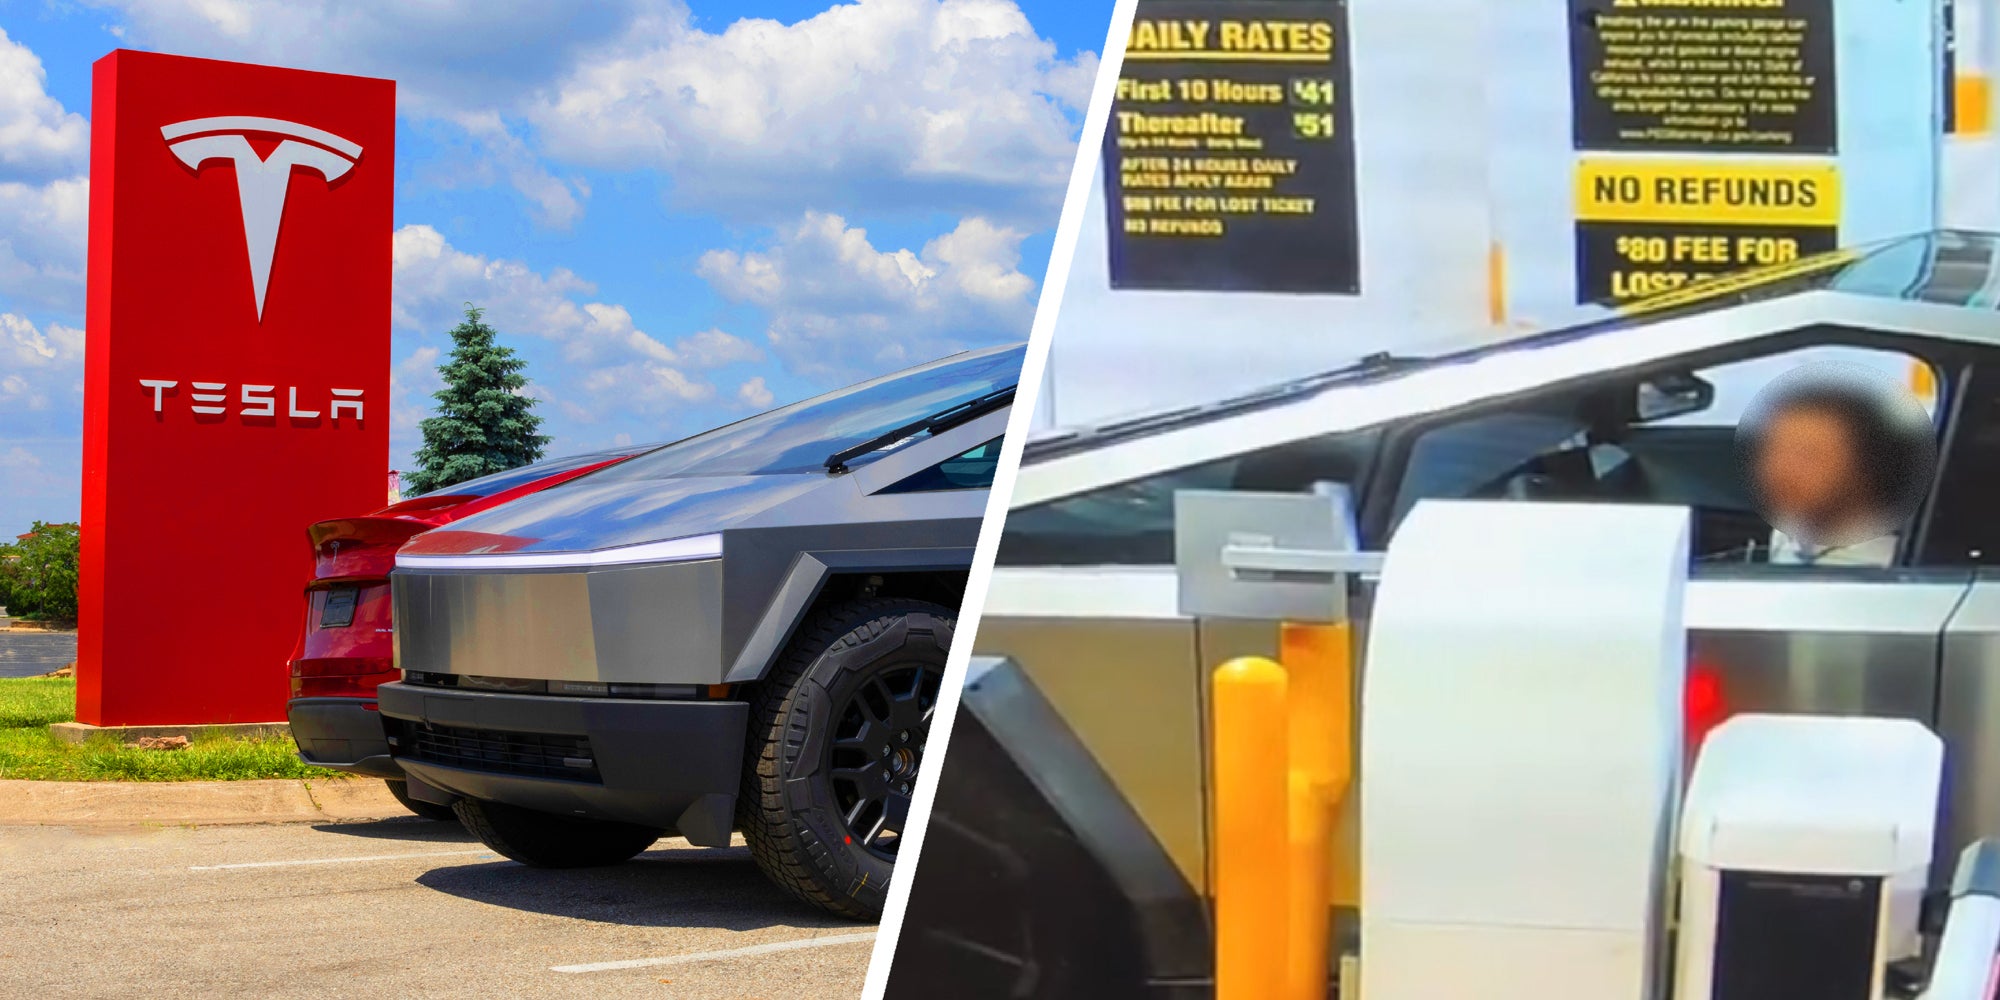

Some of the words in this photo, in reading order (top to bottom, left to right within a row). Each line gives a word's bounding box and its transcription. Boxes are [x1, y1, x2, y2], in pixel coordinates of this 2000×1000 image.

[1126, 20, 1209, 49] AILY
[1219, 20, 1333, 50] RATES
[1116, 79, 1172, 100] First
[1177, 79, 1207, 100] 10
[1212, 79, 1284, 102] Hours
[1117, 111, 1244, 134] Thereafter
[1220, 198, 1258, 212] LOST
[1594, 176, 1641, 204] NO
[1654, 176, 1817, 208] REFUNDS
[1616, 235, 1667, 262] $80
[1673, 236, 1729, 262] FEE
[1736, 237, 1798, 263] FOR
[1611, 271, 1688, 297] LOST
[139, 379, 364, 420] TESLA
